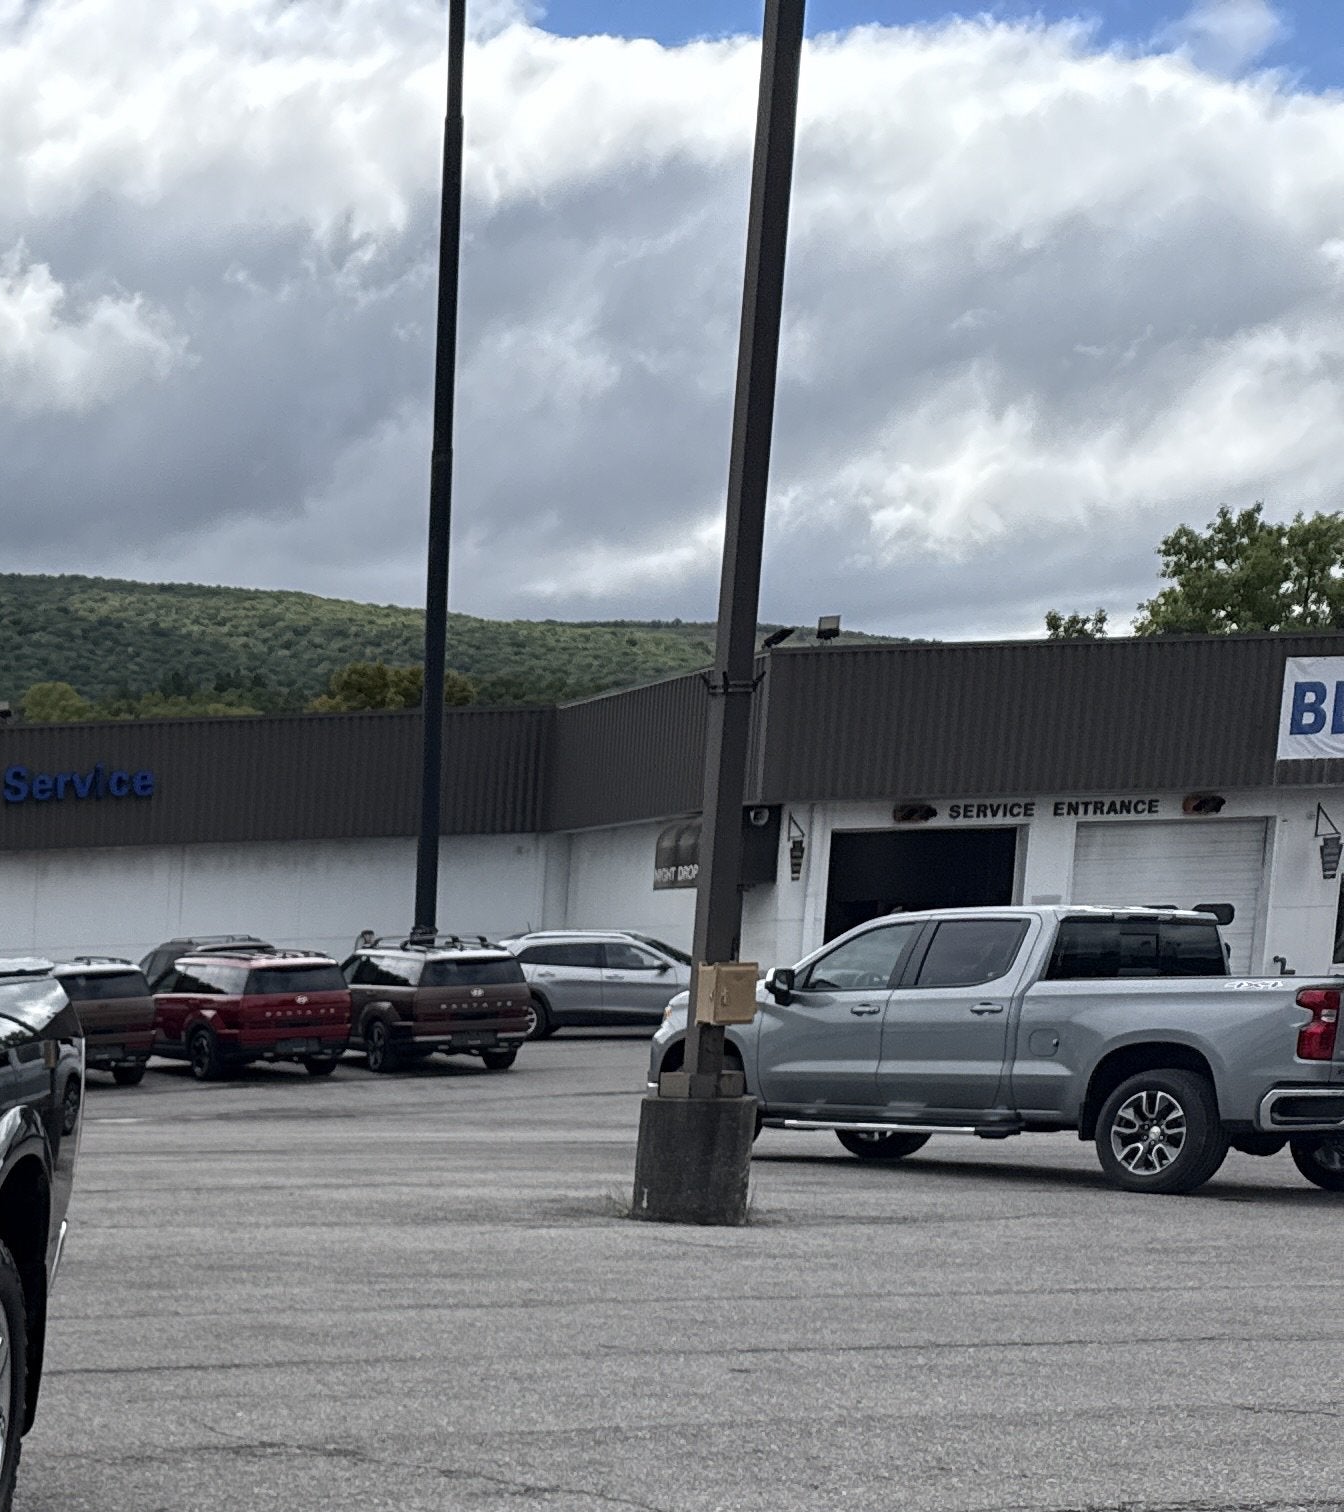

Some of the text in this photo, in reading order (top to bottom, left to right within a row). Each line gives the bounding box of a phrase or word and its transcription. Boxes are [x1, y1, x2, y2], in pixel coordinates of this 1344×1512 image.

[2, 761, 155, 805] Service
[948, 799, 1160, 819] SERVICE ENTRANCE
[677, 863, 699, 881] DROP
